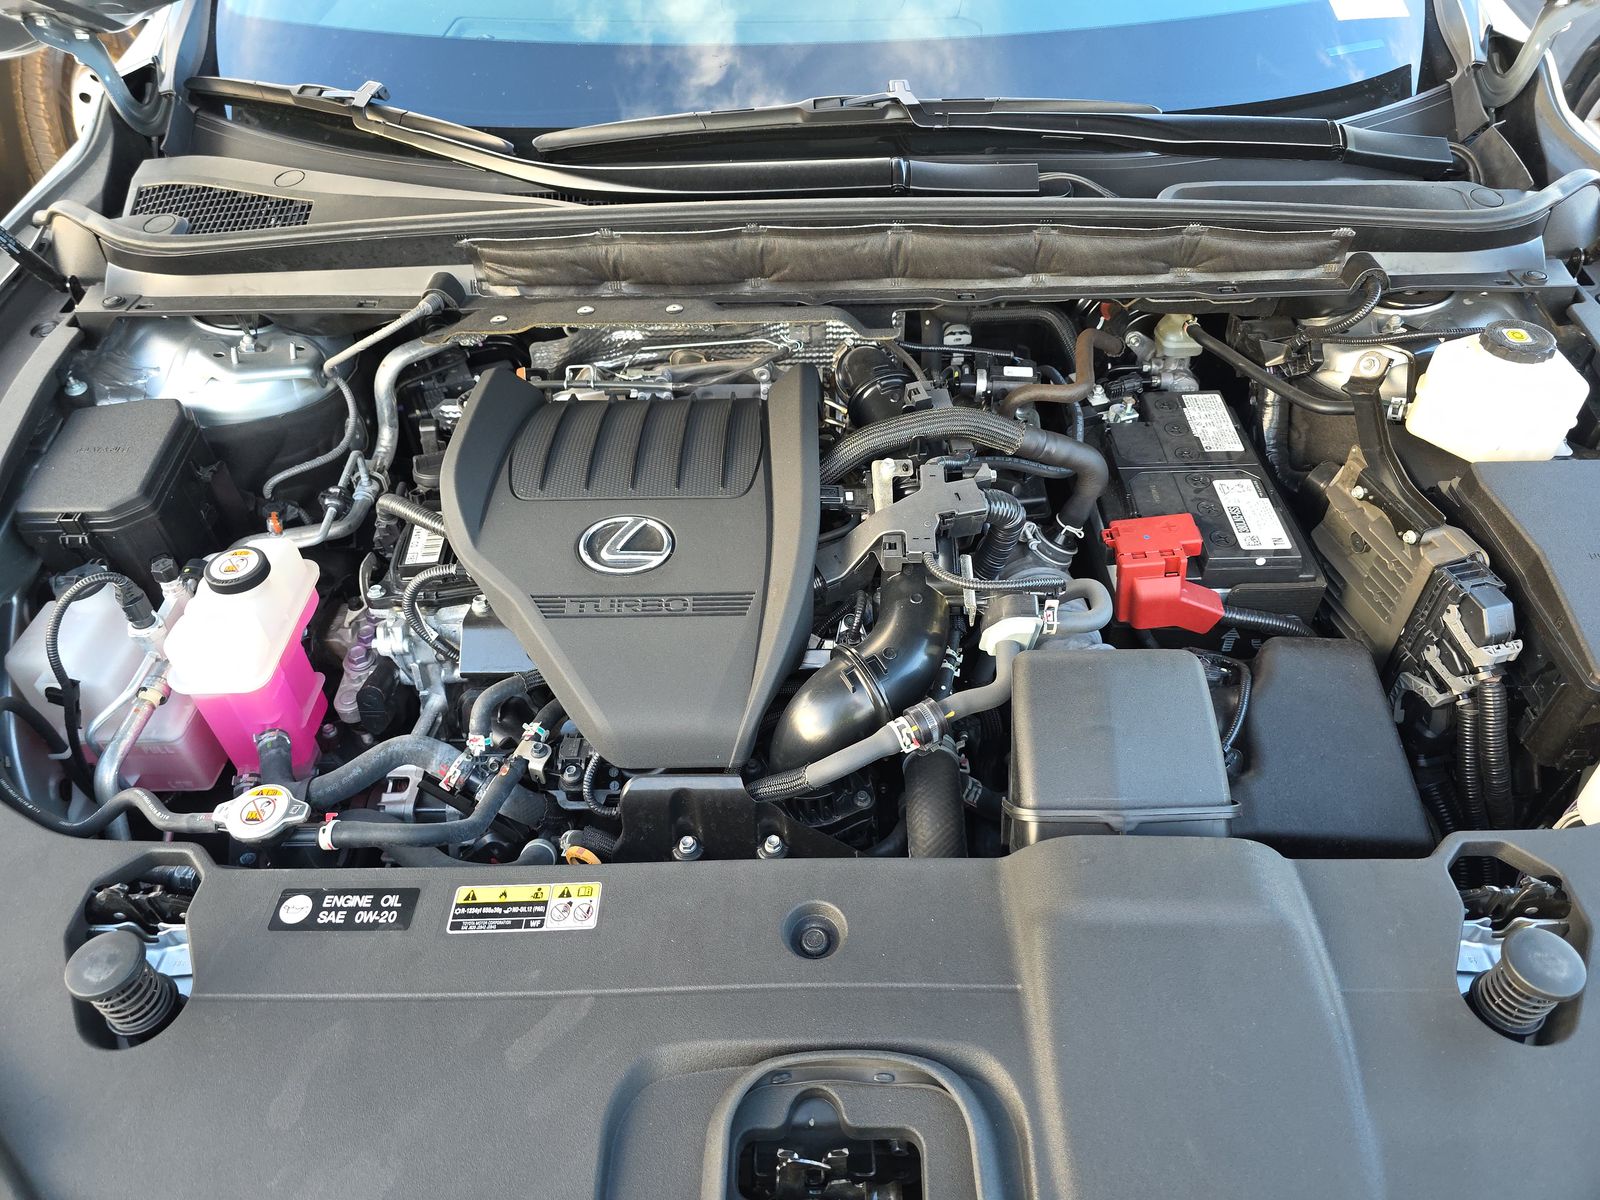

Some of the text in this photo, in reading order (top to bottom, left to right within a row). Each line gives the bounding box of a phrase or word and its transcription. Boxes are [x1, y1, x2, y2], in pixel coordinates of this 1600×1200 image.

[570, 597, 689, 613] TURBO
[322, 894, 402, 908] ENGINE OIL
[316, 910, 398, 924] SAE 0W-20
[530, 919, 541, 928] WF
